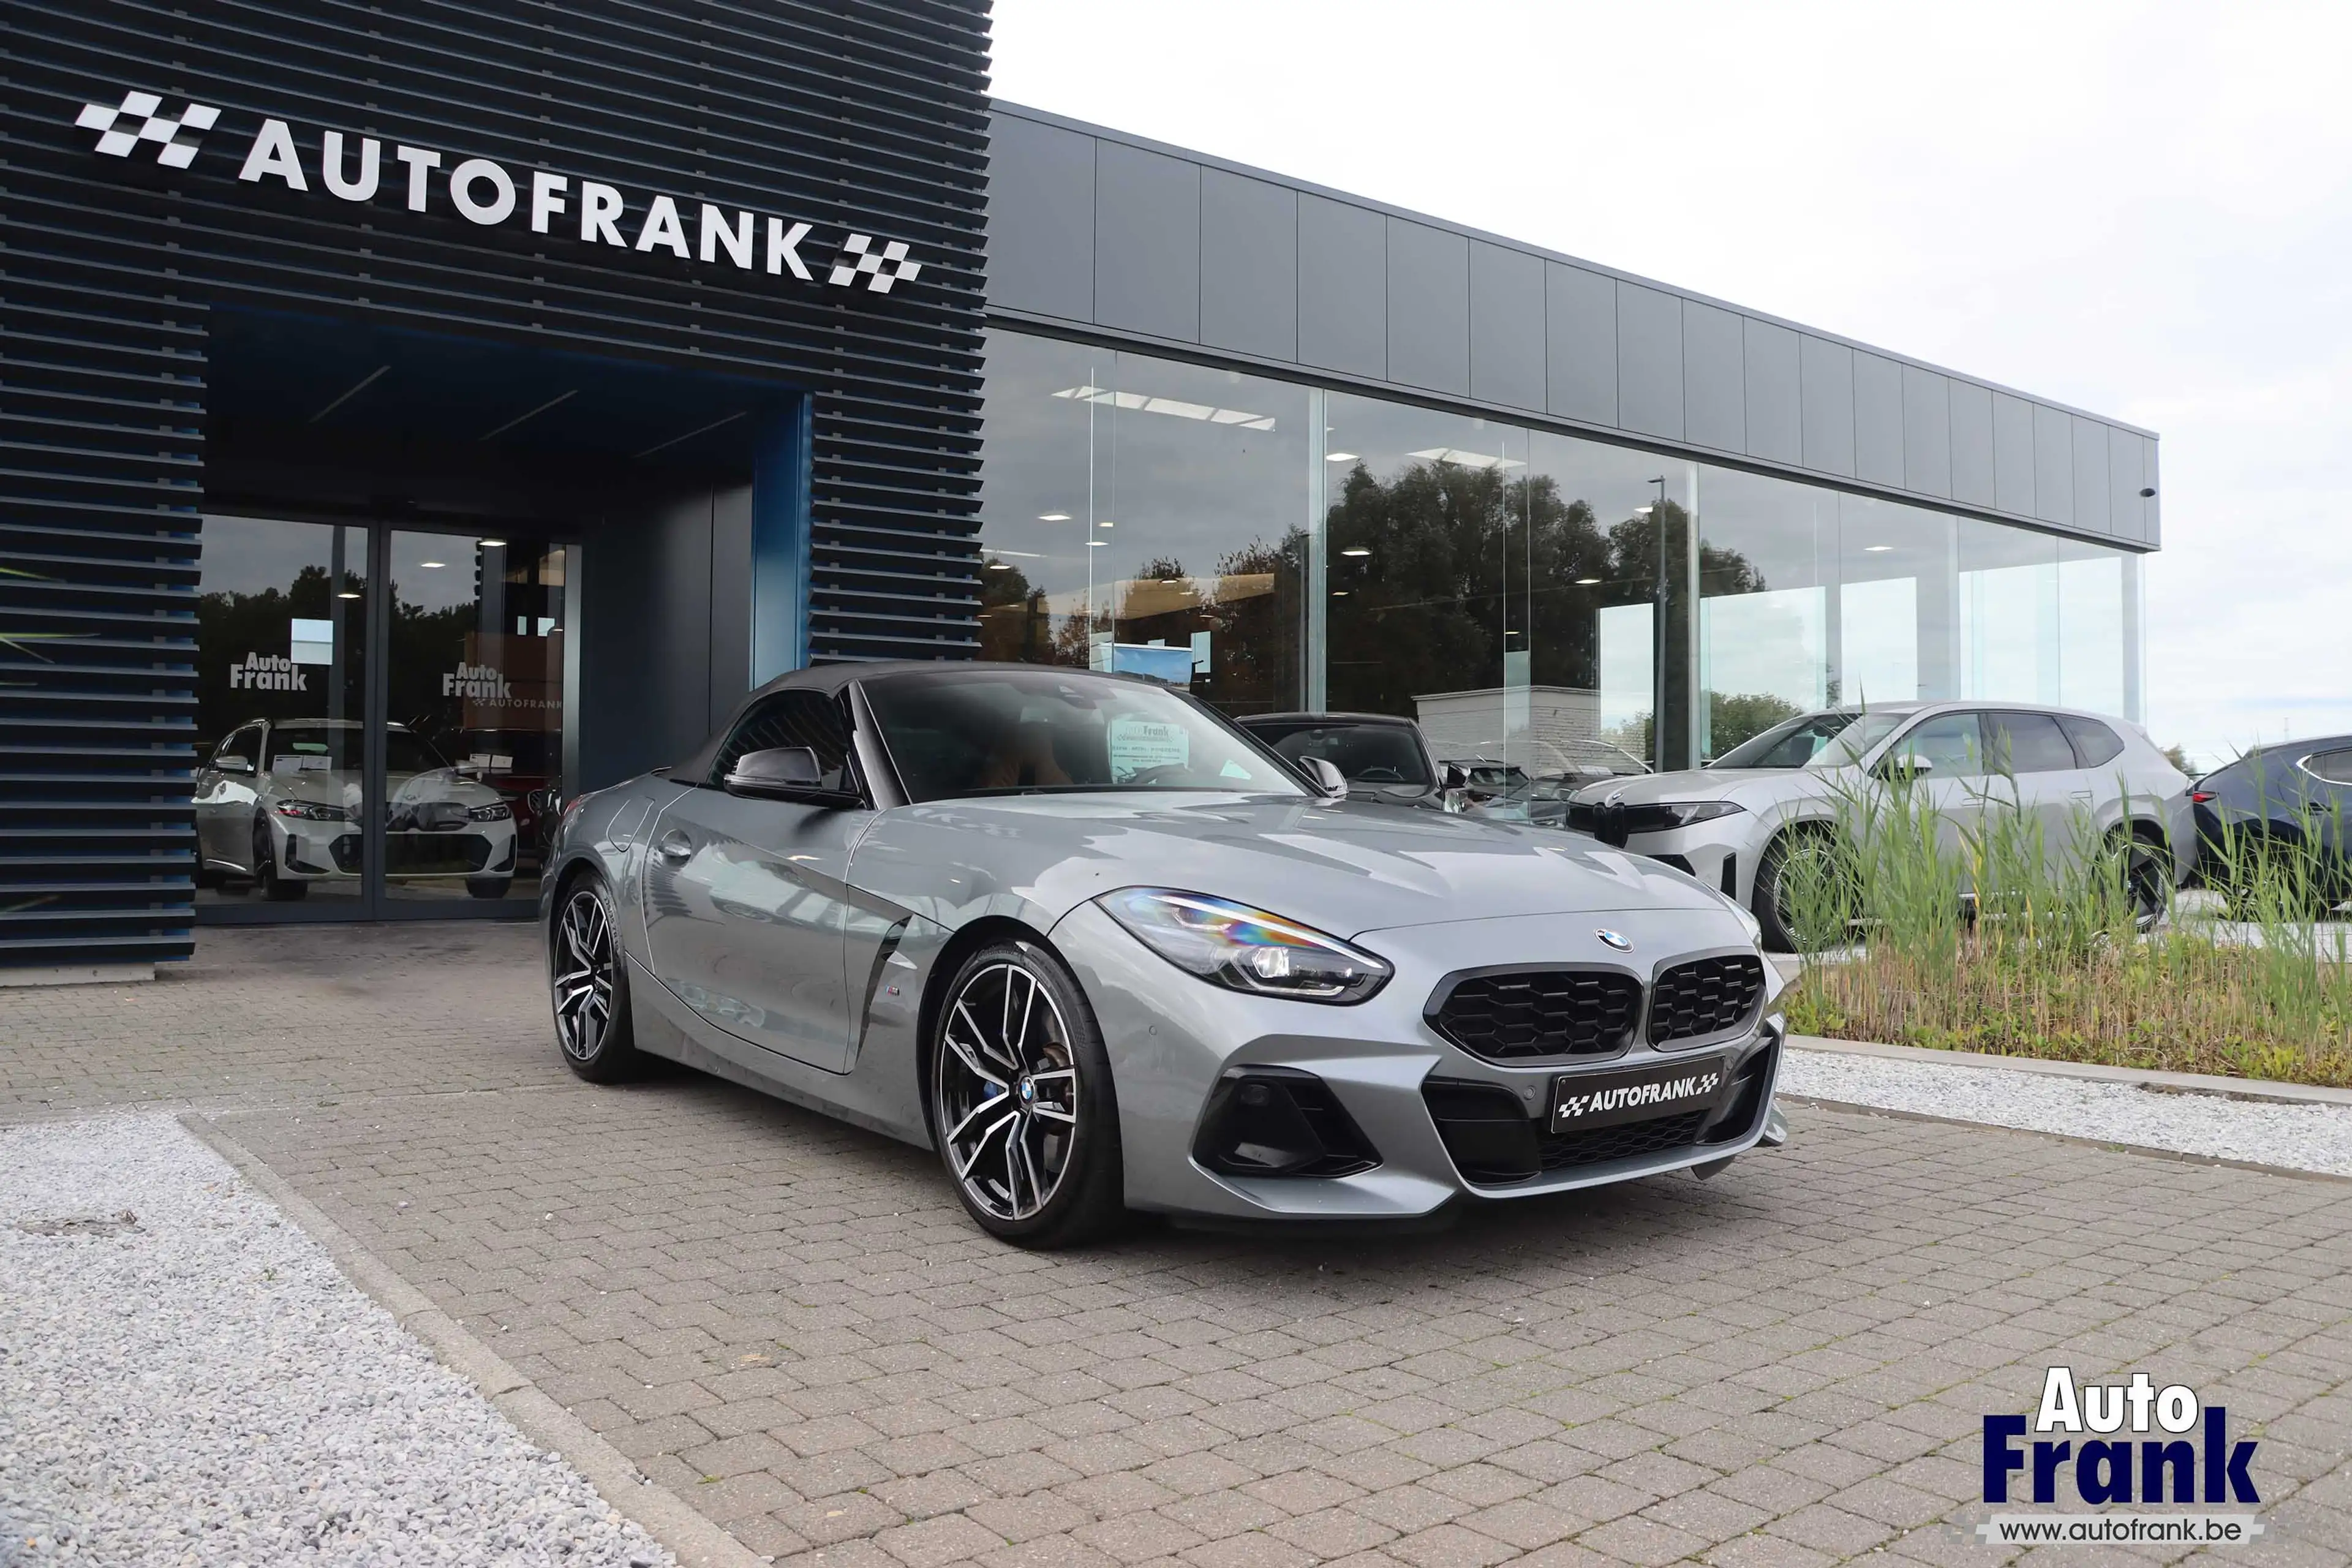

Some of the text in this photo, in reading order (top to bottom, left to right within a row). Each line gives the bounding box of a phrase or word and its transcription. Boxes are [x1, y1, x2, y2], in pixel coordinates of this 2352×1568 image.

[238, 119, 813, 281] AUTOFRANK
[245, 652, 291, 671] Auto
[456, 662, 497, 680] Auto
[230, 664, 307, 690] Frank
[443, 673, 511, 698] Frank
[489, 699, 562, 709] AUTOFRANK
[1589, 1076, 1697, 1112] AUTOFRANK
